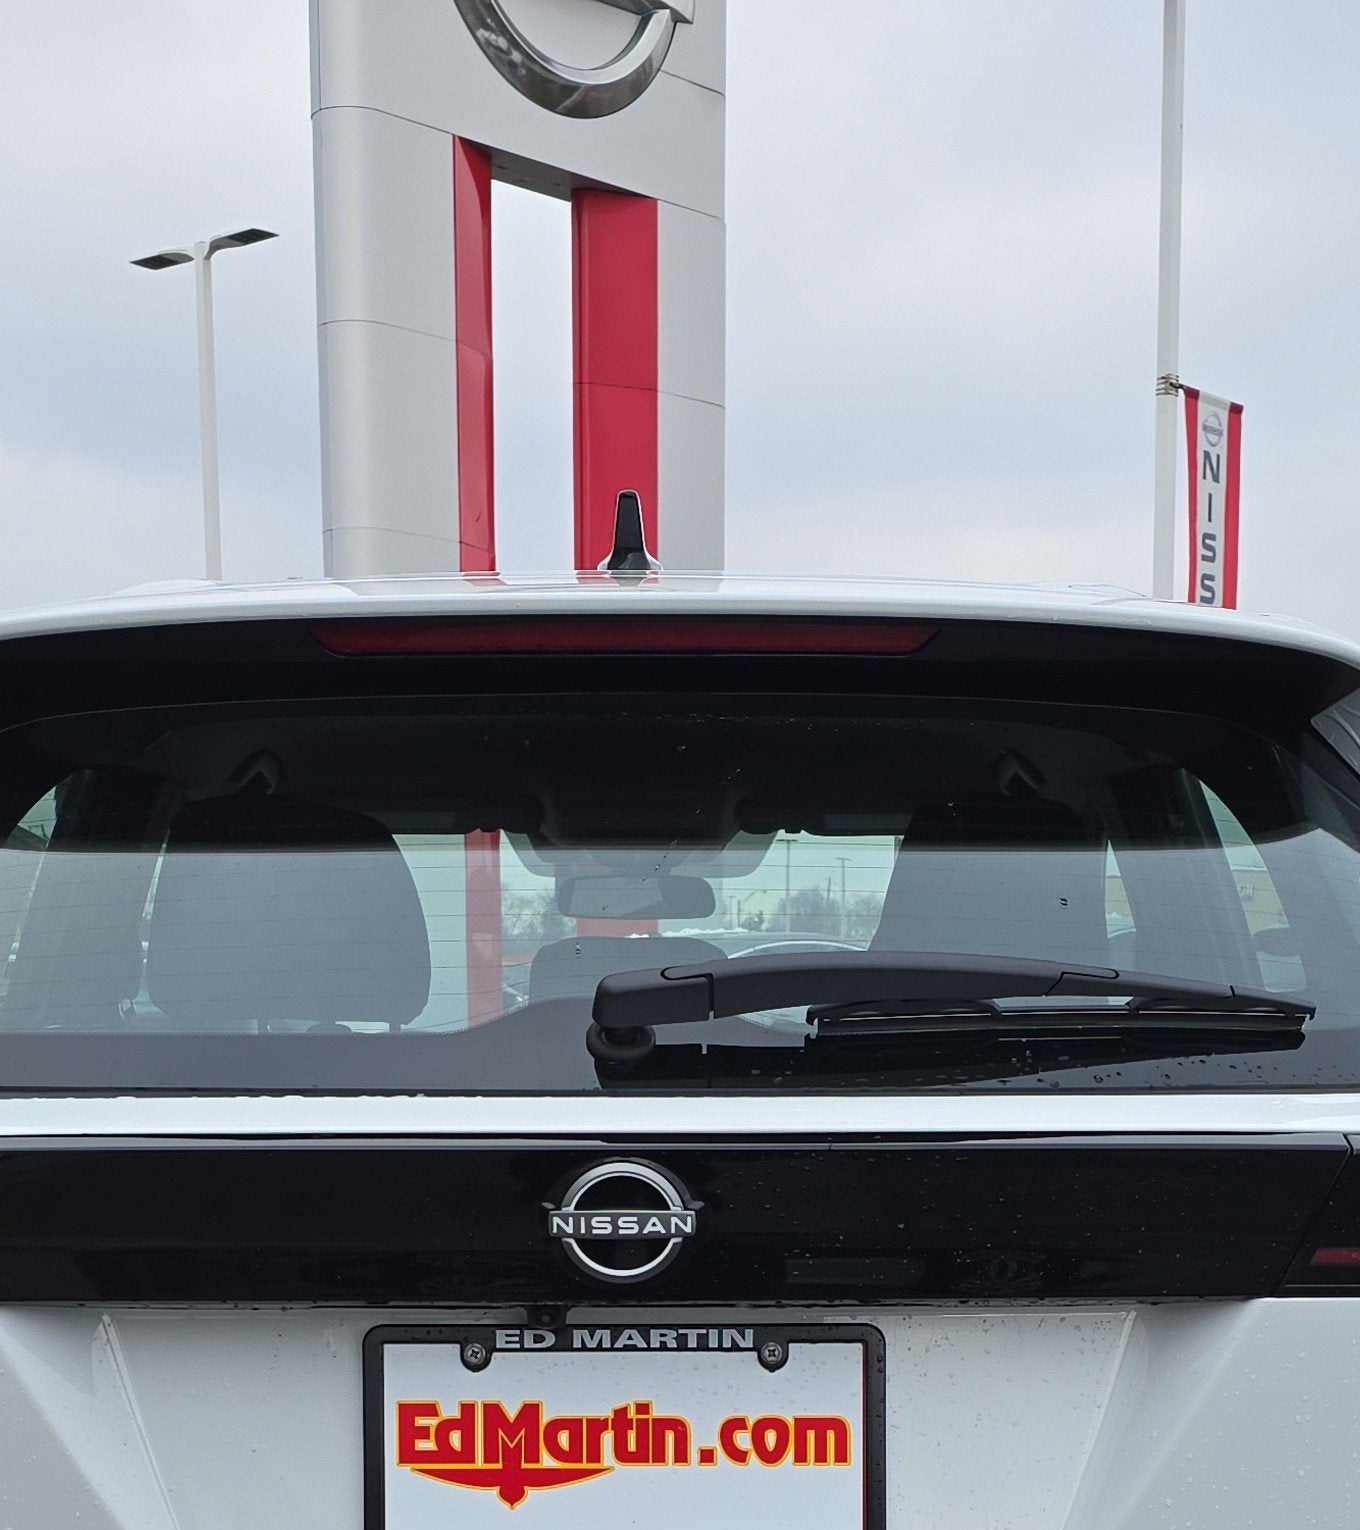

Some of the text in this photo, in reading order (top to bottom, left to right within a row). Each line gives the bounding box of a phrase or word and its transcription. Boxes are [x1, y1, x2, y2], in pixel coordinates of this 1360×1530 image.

[552, 1212, 693, 1235] NISSAN
[495, 1328, 754, 1349] ED MARTIN
[396, 1399, 851, 1467] EdMartin.com
